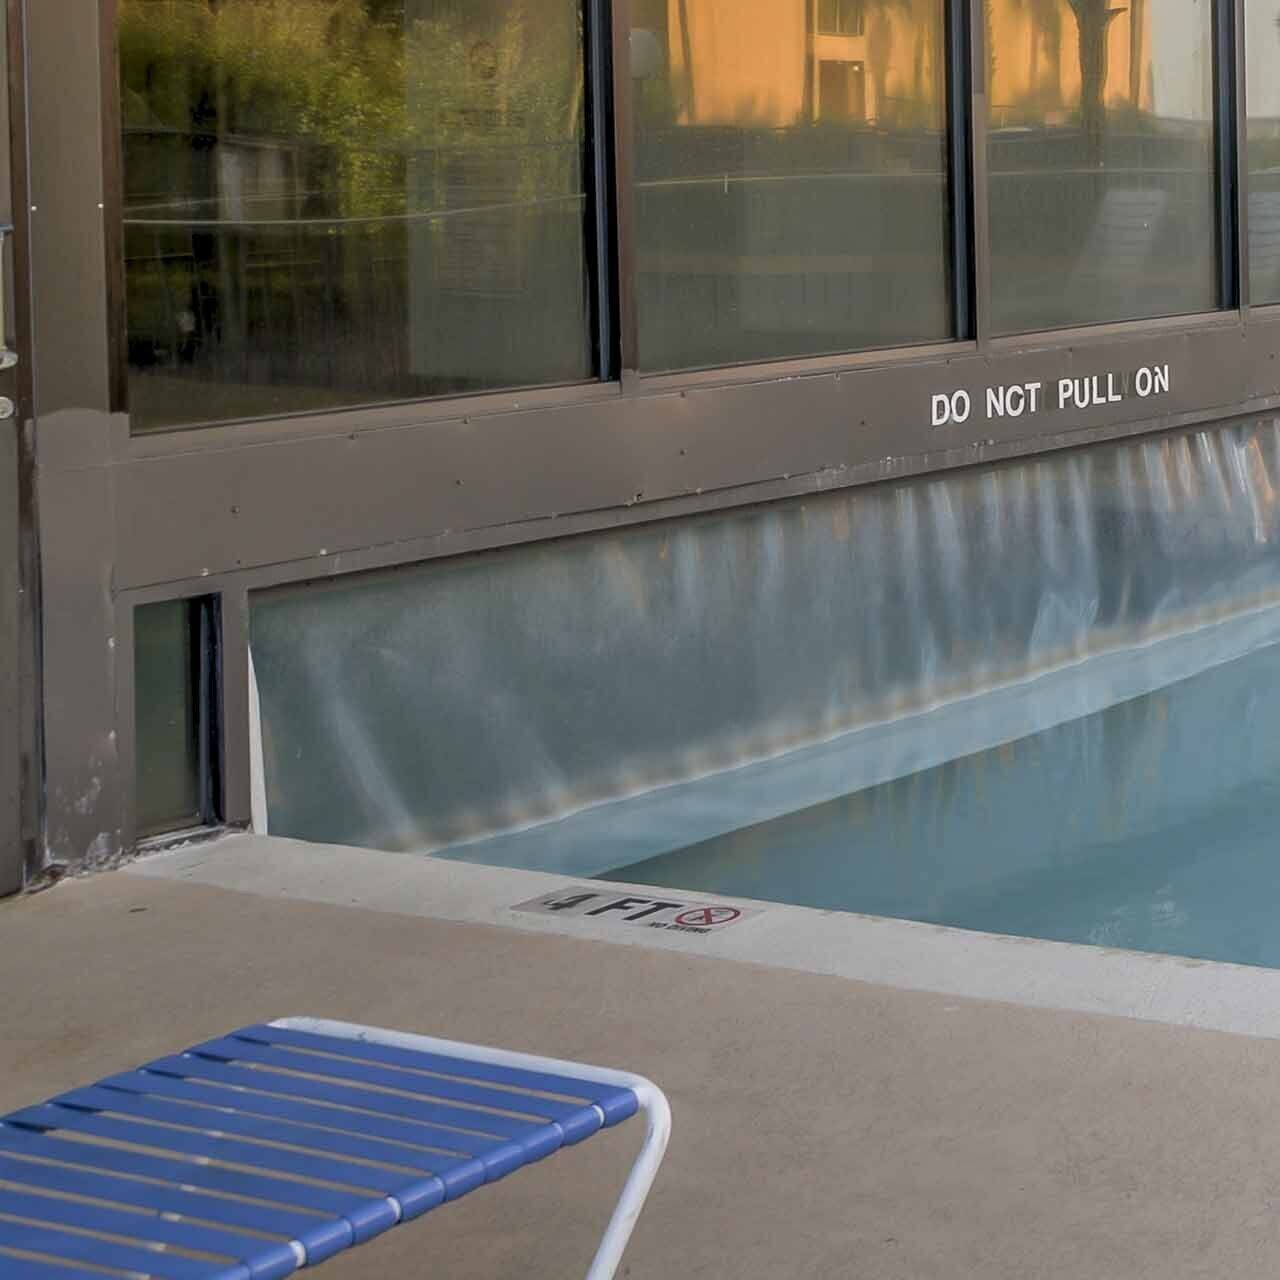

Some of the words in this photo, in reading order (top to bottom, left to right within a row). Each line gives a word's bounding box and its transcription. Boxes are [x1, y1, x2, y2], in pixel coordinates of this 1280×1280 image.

[930, 389, 971, 426] DO
[985, 382, 1041, 418] NOT
[1058, 373, 1122, 409] PULL
[1135, 364, 1170, 397] ON
[584, 897, 684, 921] FT
